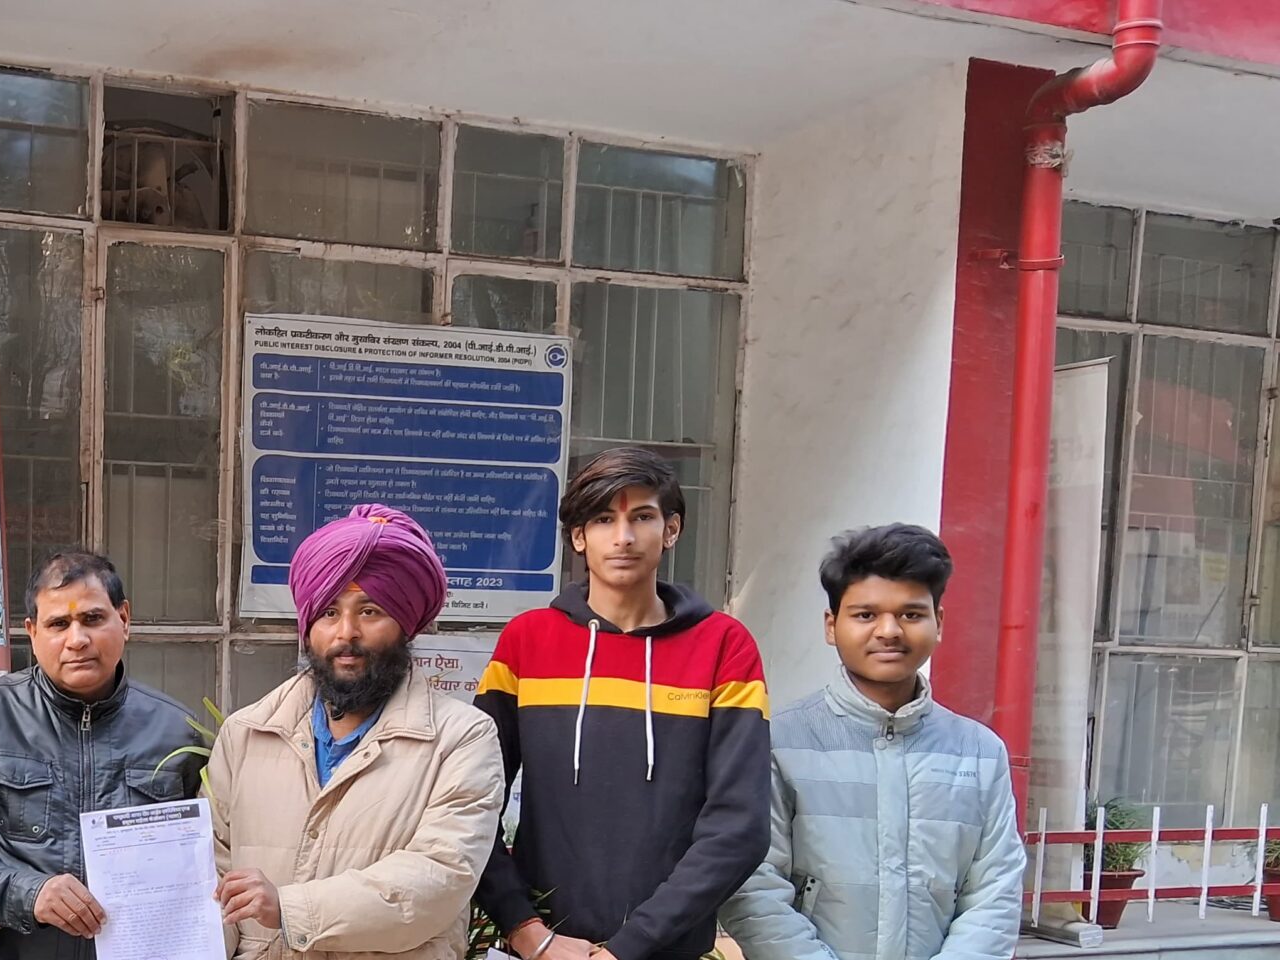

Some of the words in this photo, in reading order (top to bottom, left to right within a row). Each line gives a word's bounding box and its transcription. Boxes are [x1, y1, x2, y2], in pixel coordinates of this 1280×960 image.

[334, 331, 349, 342] और
[443, 341, 462, 349] 2004
[254, 340, 279, 348] PUBLIC
[280, 342, 313, 350] INTEREST
[314, 344, 357, 354] DISCLOSURE
[364, 348, 407, 357] PROTECTION
[418, 352, 453, 360] INFORMER
[476, 577, 503, 587] 2023
[429, 675, 462, 691] रिवार
[667, 691, 710, 701] CalvinKle
